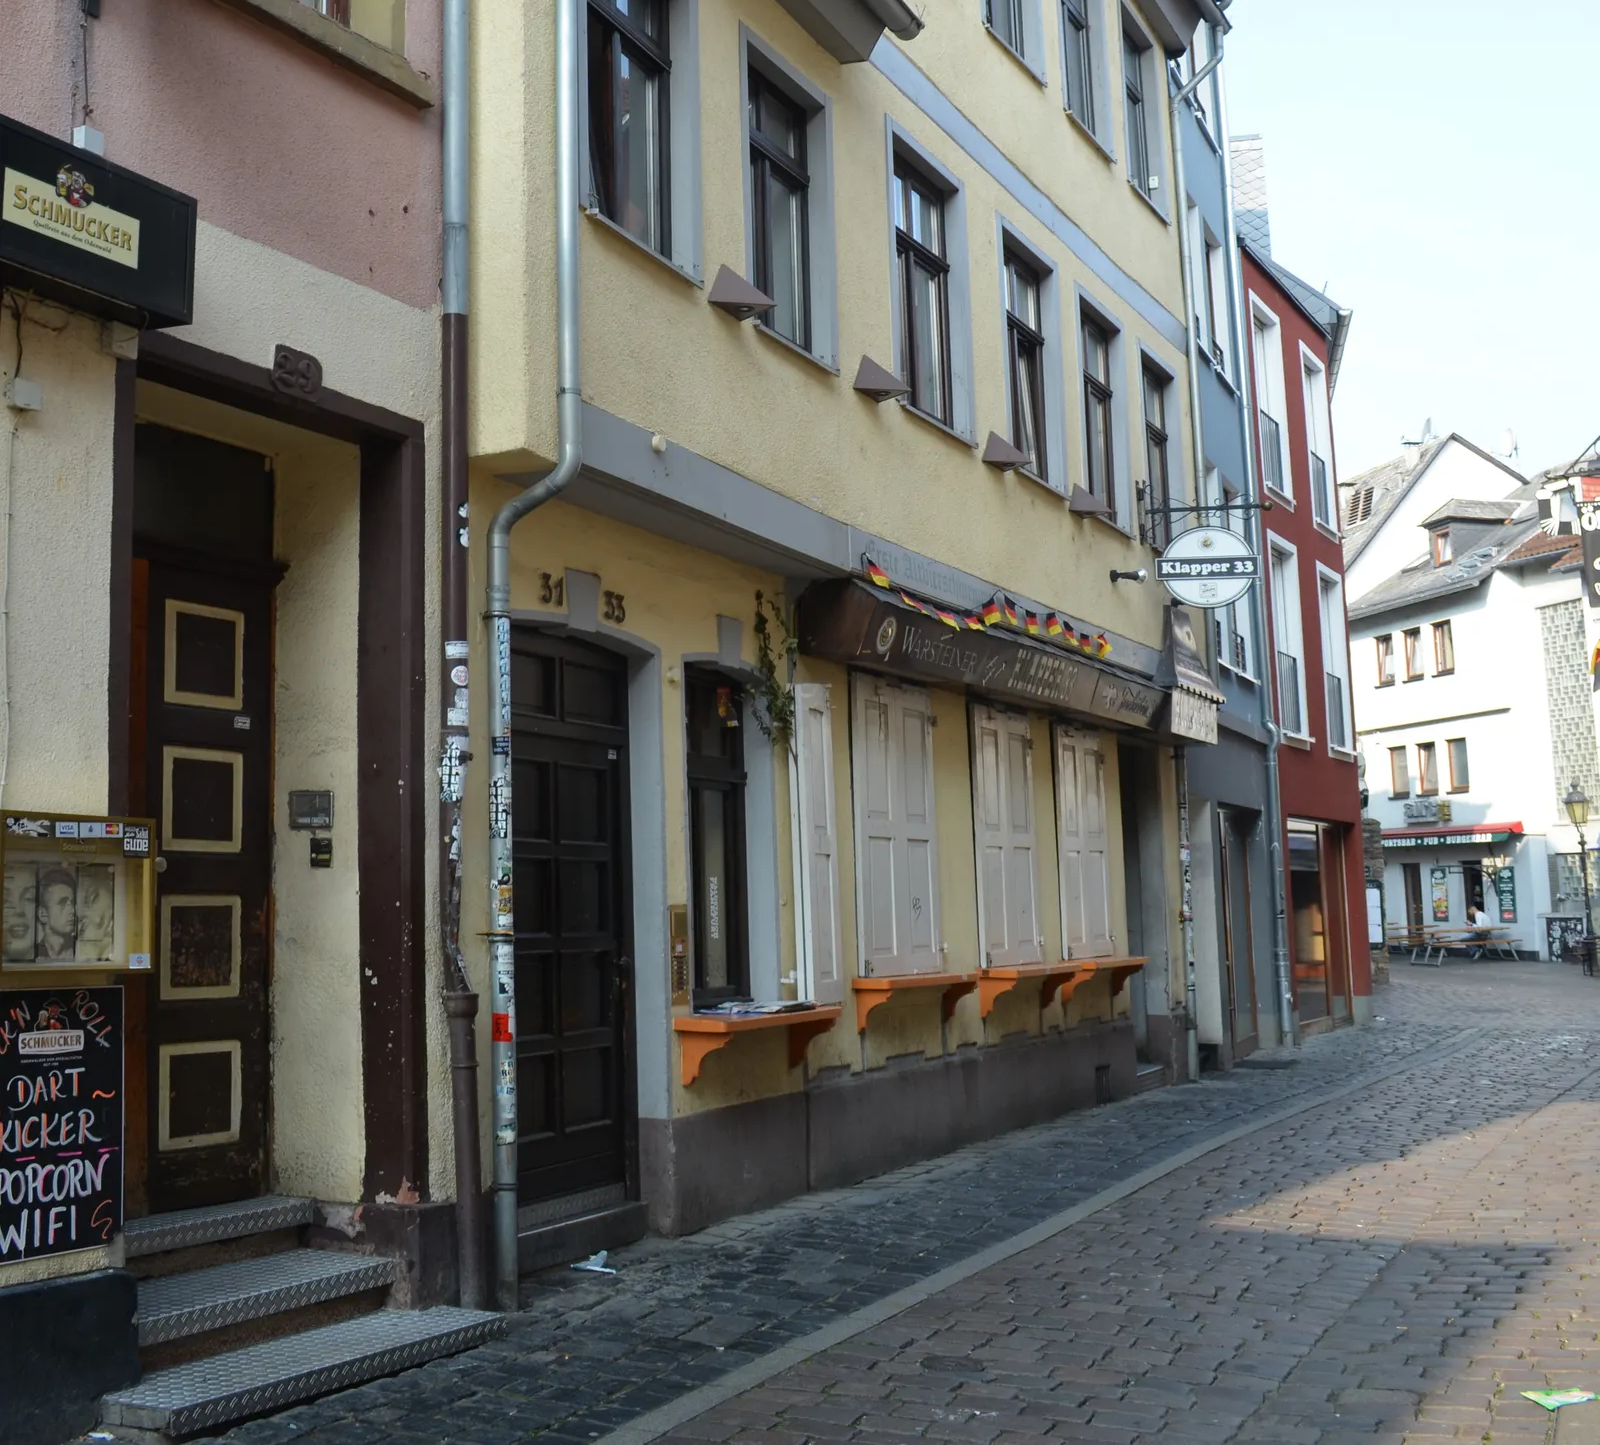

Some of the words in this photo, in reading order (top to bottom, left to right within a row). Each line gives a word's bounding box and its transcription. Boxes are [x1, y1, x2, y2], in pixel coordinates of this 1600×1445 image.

[13, 184, 133, 252] SCHMUCKER
[539, 571, 564, 608] 31
[1161, 561, 1231, 576] Klapper
[1233, 560, 1254, 573] 33
[603, 589, 626, 624] 33
[901, 625, 978, 674] WARSTEINER
[1423, 836, 1439, 846] PUB
[1445, 833, 1493, 845] BURGERBAR
[20, 1035, 82, 1050] SCHMUCKER
[7, 1067, 86, 1111] DART
[0, 1108, 103, 1153] KICKER
[0, 1153, 110, 1205] POPCORN
[0, 1205, 76, 1257] WIFI
